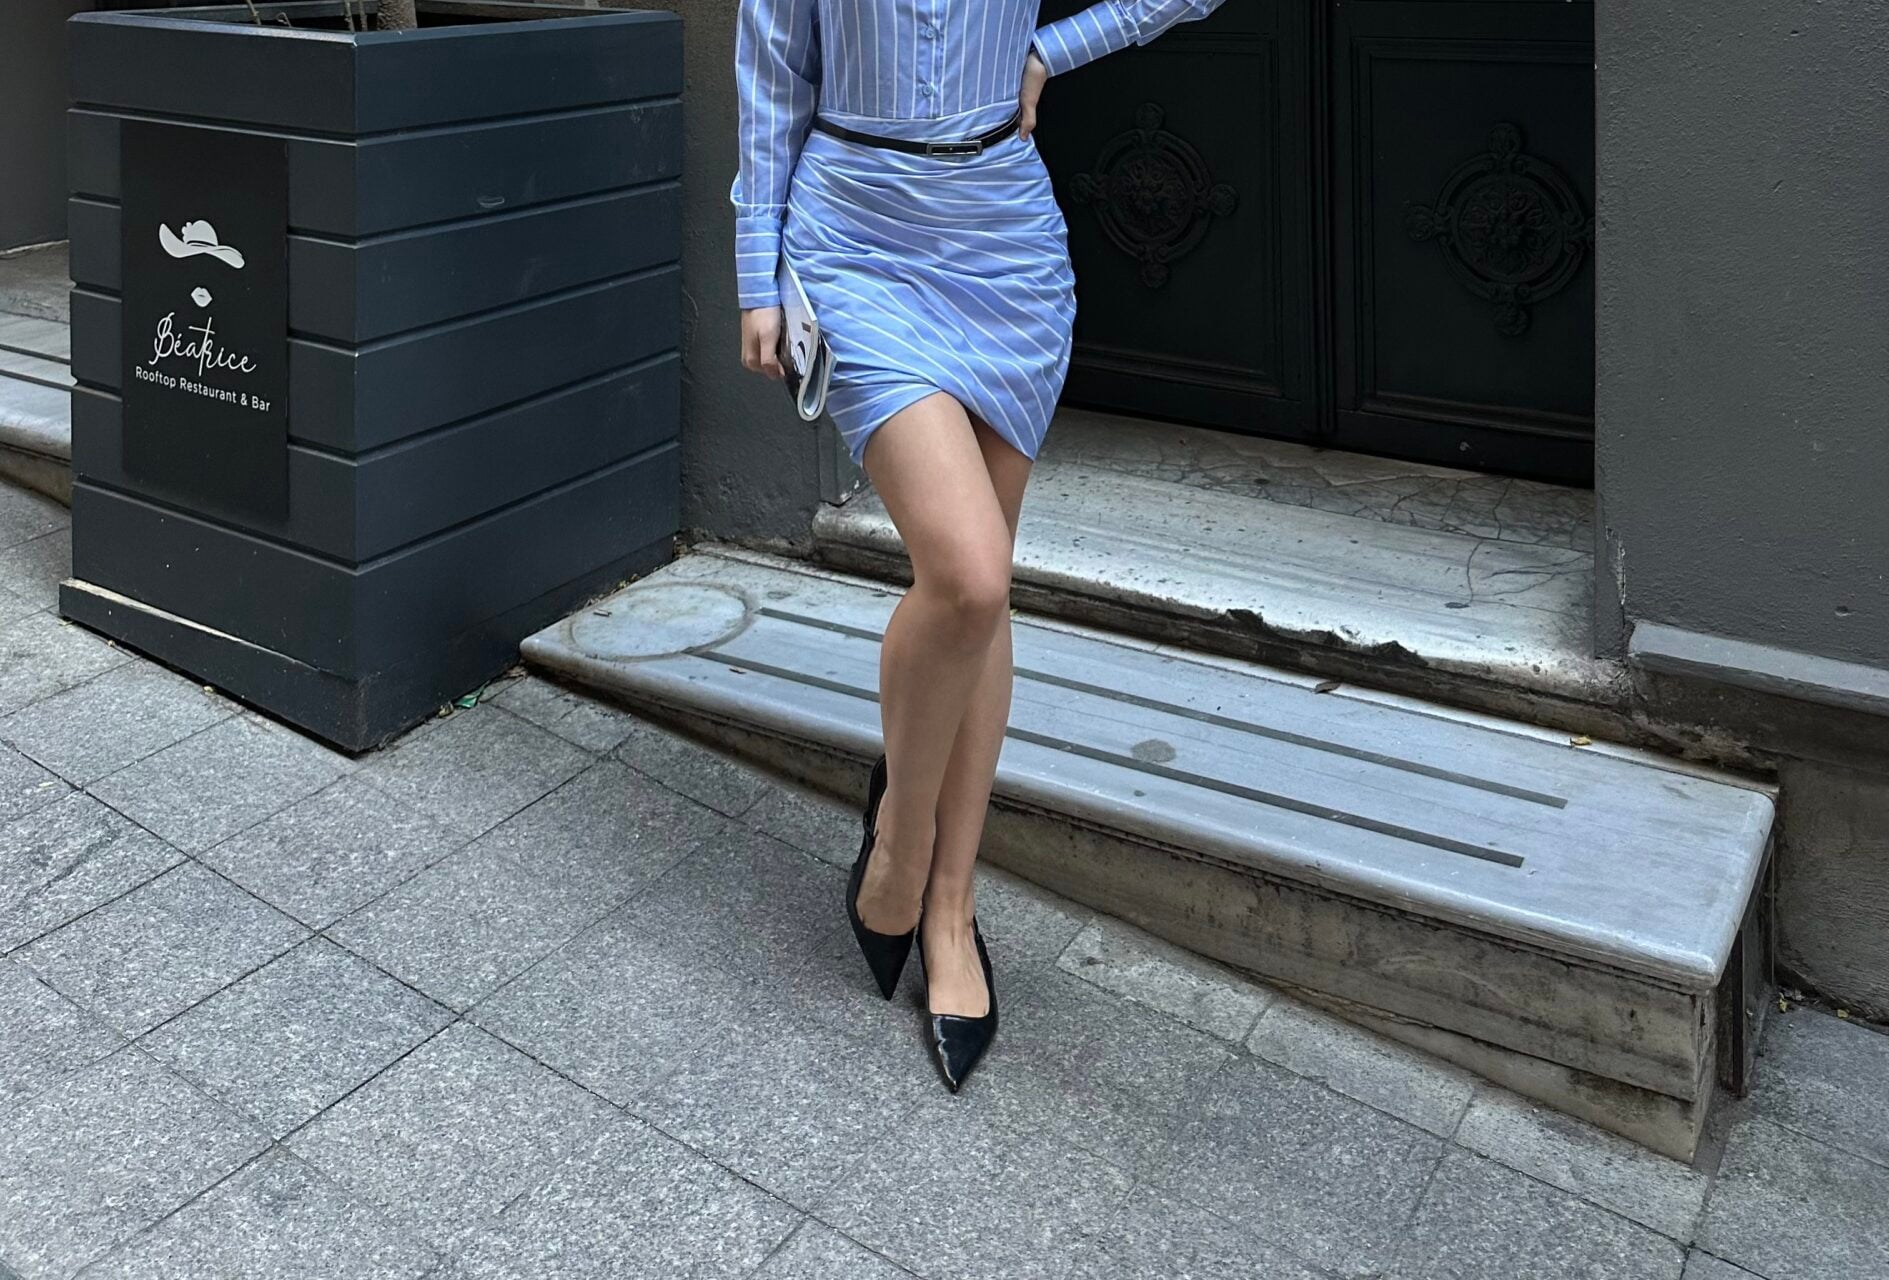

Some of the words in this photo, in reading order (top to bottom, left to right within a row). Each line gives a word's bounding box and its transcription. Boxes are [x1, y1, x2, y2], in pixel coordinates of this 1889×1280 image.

[148, 311, 257, 377] Béatrice
[135, 366, 177, 389] Rooftop
[180, 377, 237, 404] Restaurant
[240, 393, 248, 406] &
[251, 396, 271, 412] Bar
